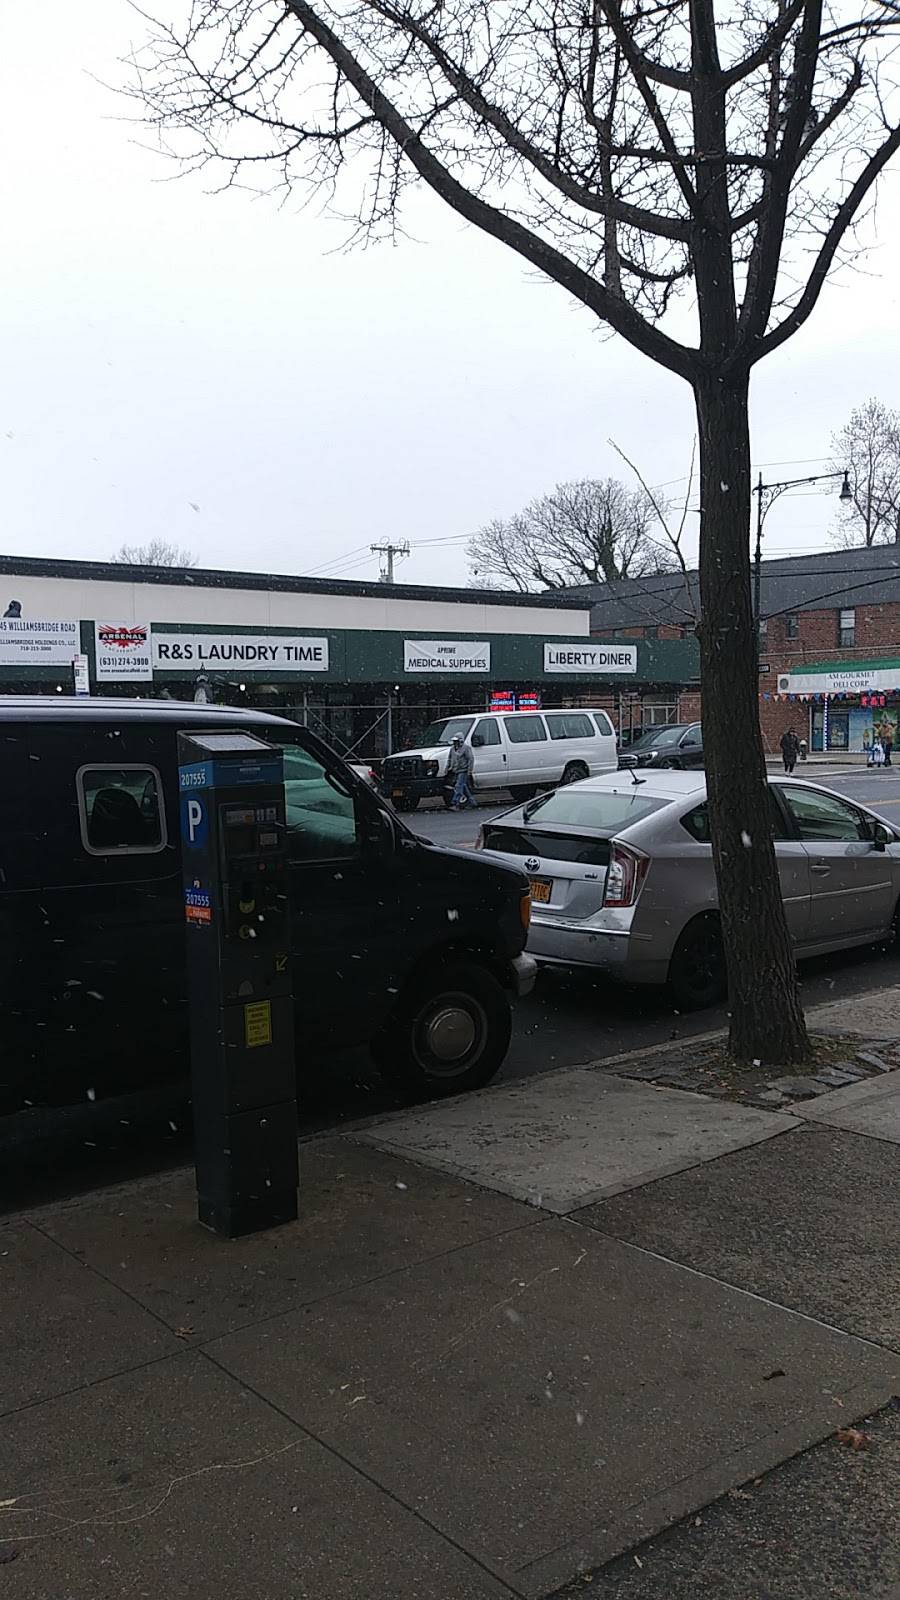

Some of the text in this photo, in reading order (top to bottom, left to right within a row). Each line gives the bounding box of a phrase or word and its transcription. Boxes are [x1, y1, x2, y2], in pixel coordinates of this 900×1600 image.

[8, 622, 60, 632] WILLIAMSBRIDGE
[60, 623, 76, 632] ROAD
[158, 643, 193, 660] R&S
[198, 644, 279, 661] LAUNDRY
[283, 646, 323, 661] TIME
[548, 652, 632, 665] LIBERTY DINER
[100, 657, 149, 667] (631) 274-3900
[408, 658, 487, 668] MEDICAL SUPPLIES
[840, 671, 875, 679] GOURMET
[181, 773, 206, 786] 207555
[188, 800, 202, 841] P
[186, 893, 210, 907] 207555
